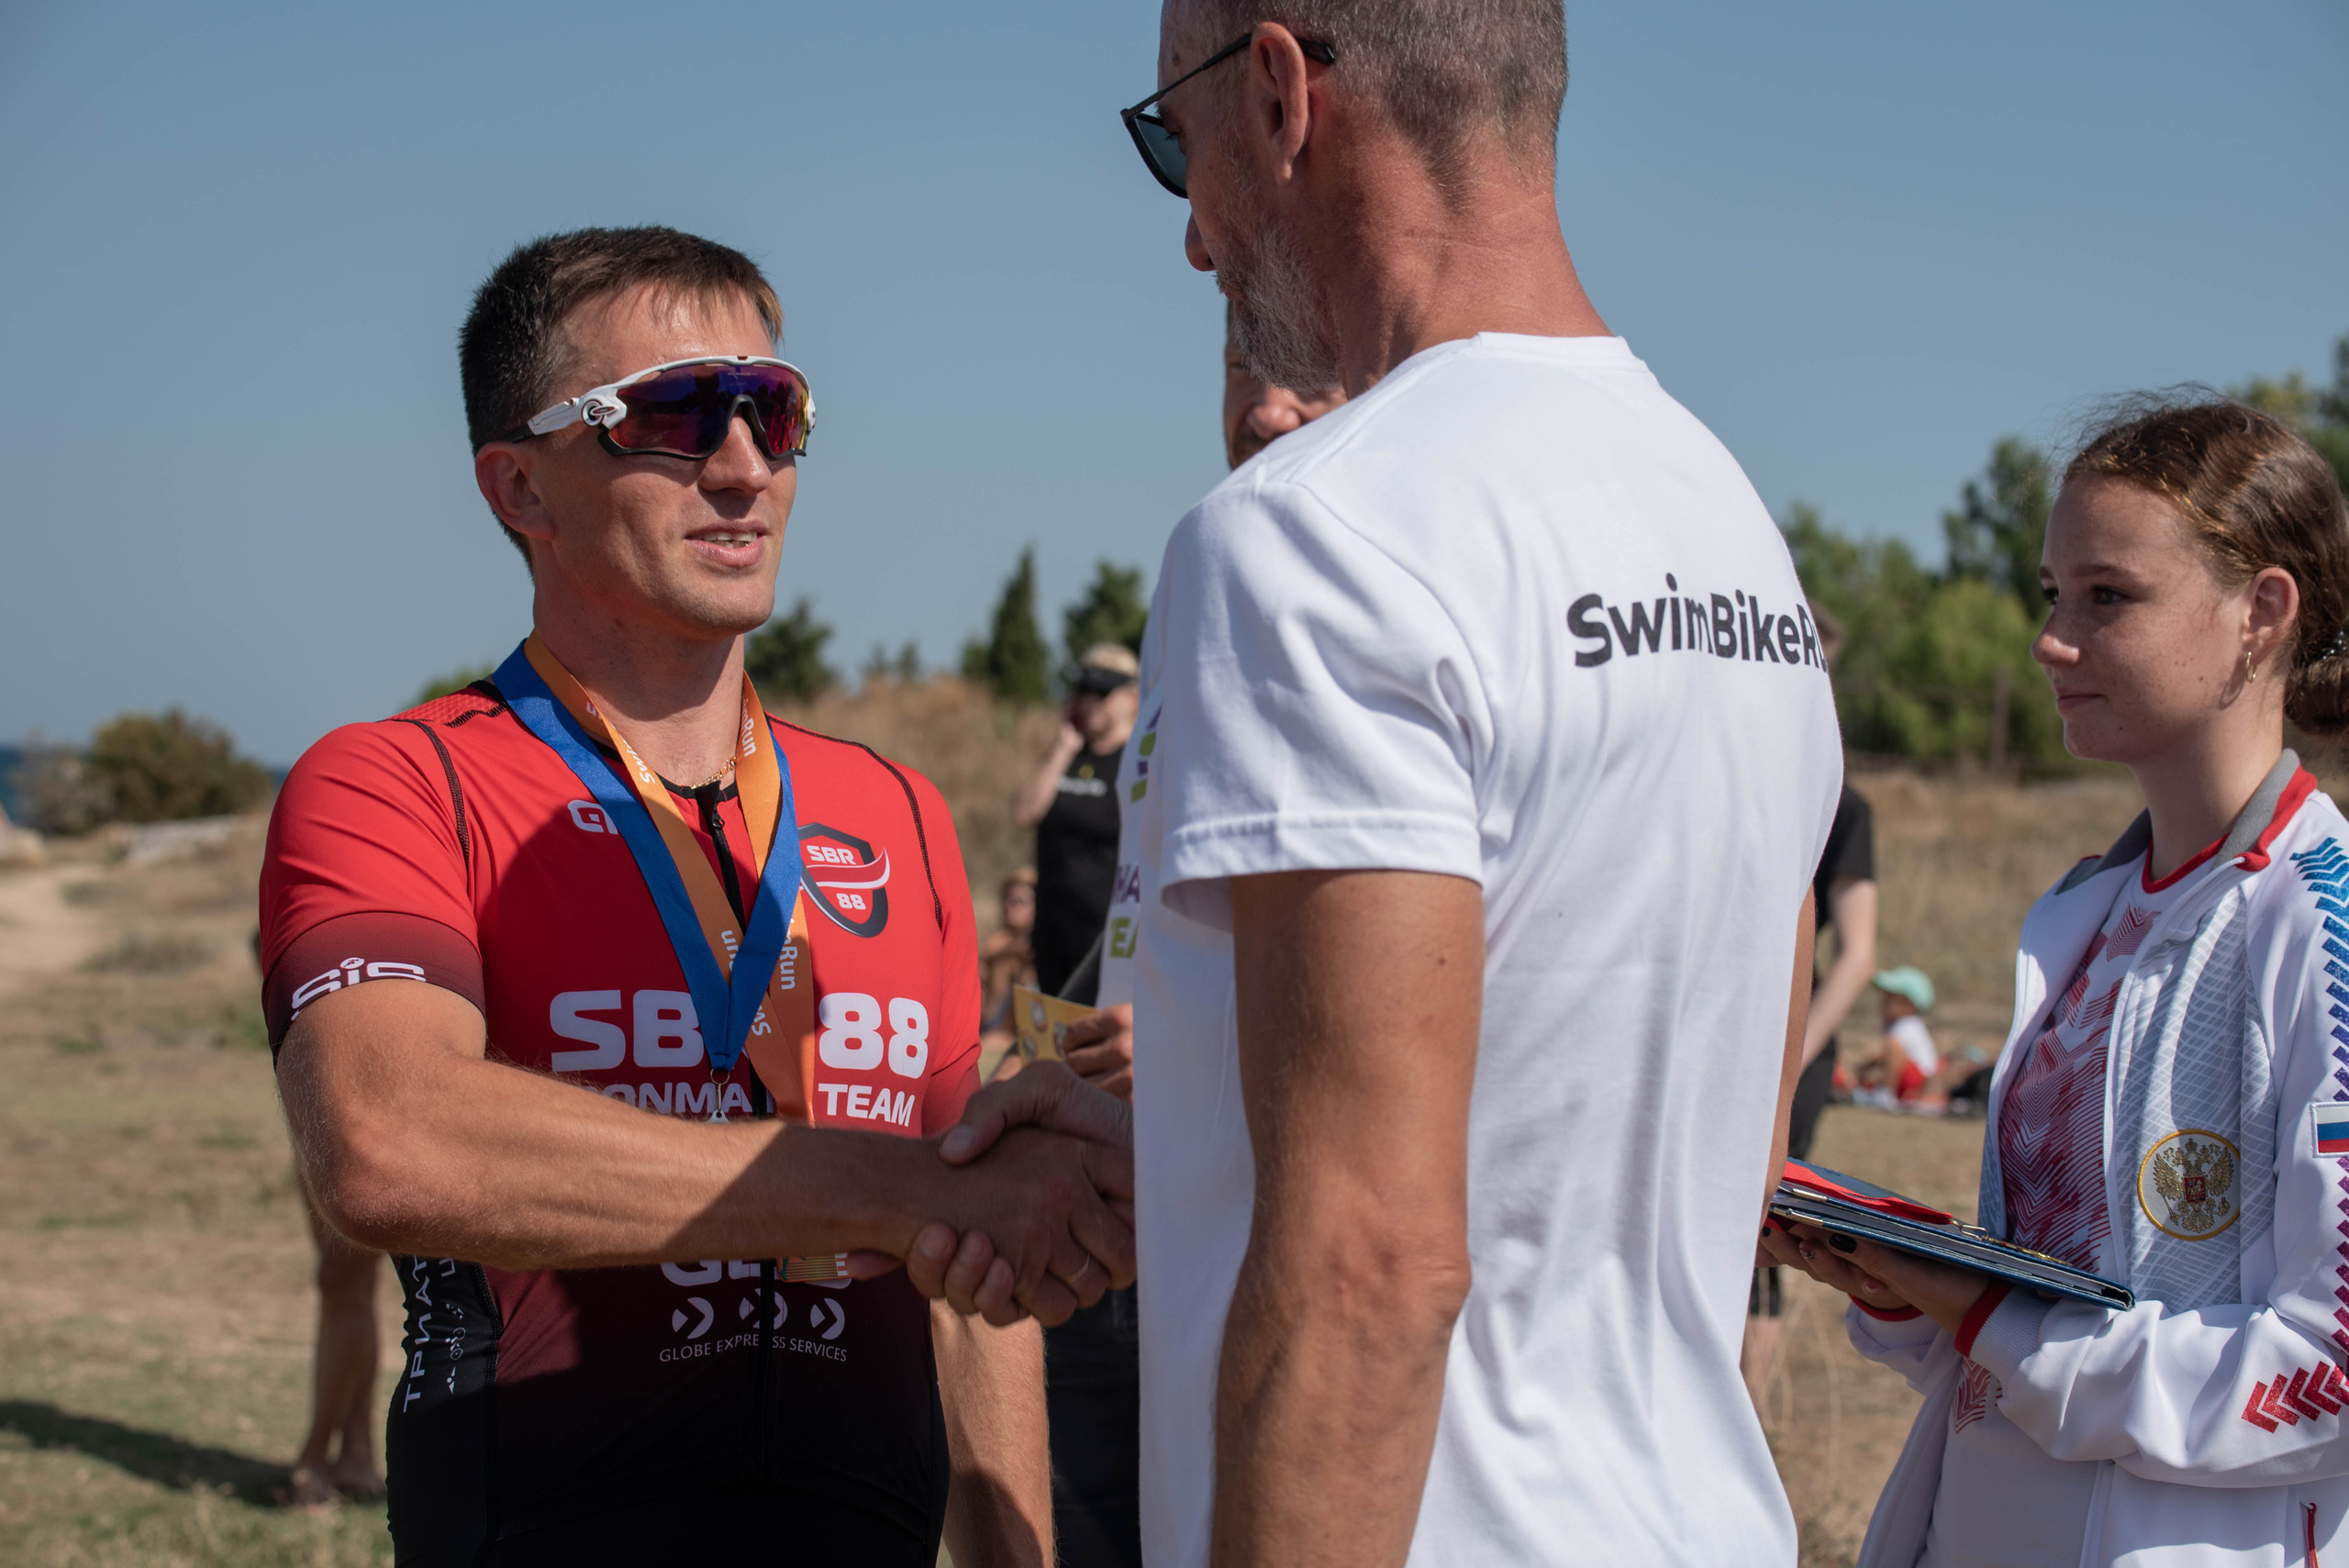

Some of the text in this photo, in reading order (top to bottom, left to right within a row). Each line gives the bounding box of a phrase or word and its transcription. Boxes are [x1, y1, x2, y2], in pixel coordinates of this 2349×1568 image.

[807, 845, 857, 865] SBR
[836, 893, 866, 910] 88
[551, 989, 929, 1079] SB 88
[818, 1084, 916, 1128] TEAM
[659, 1334, 848, 1362] GLOBE EXPRESS SERVICES
